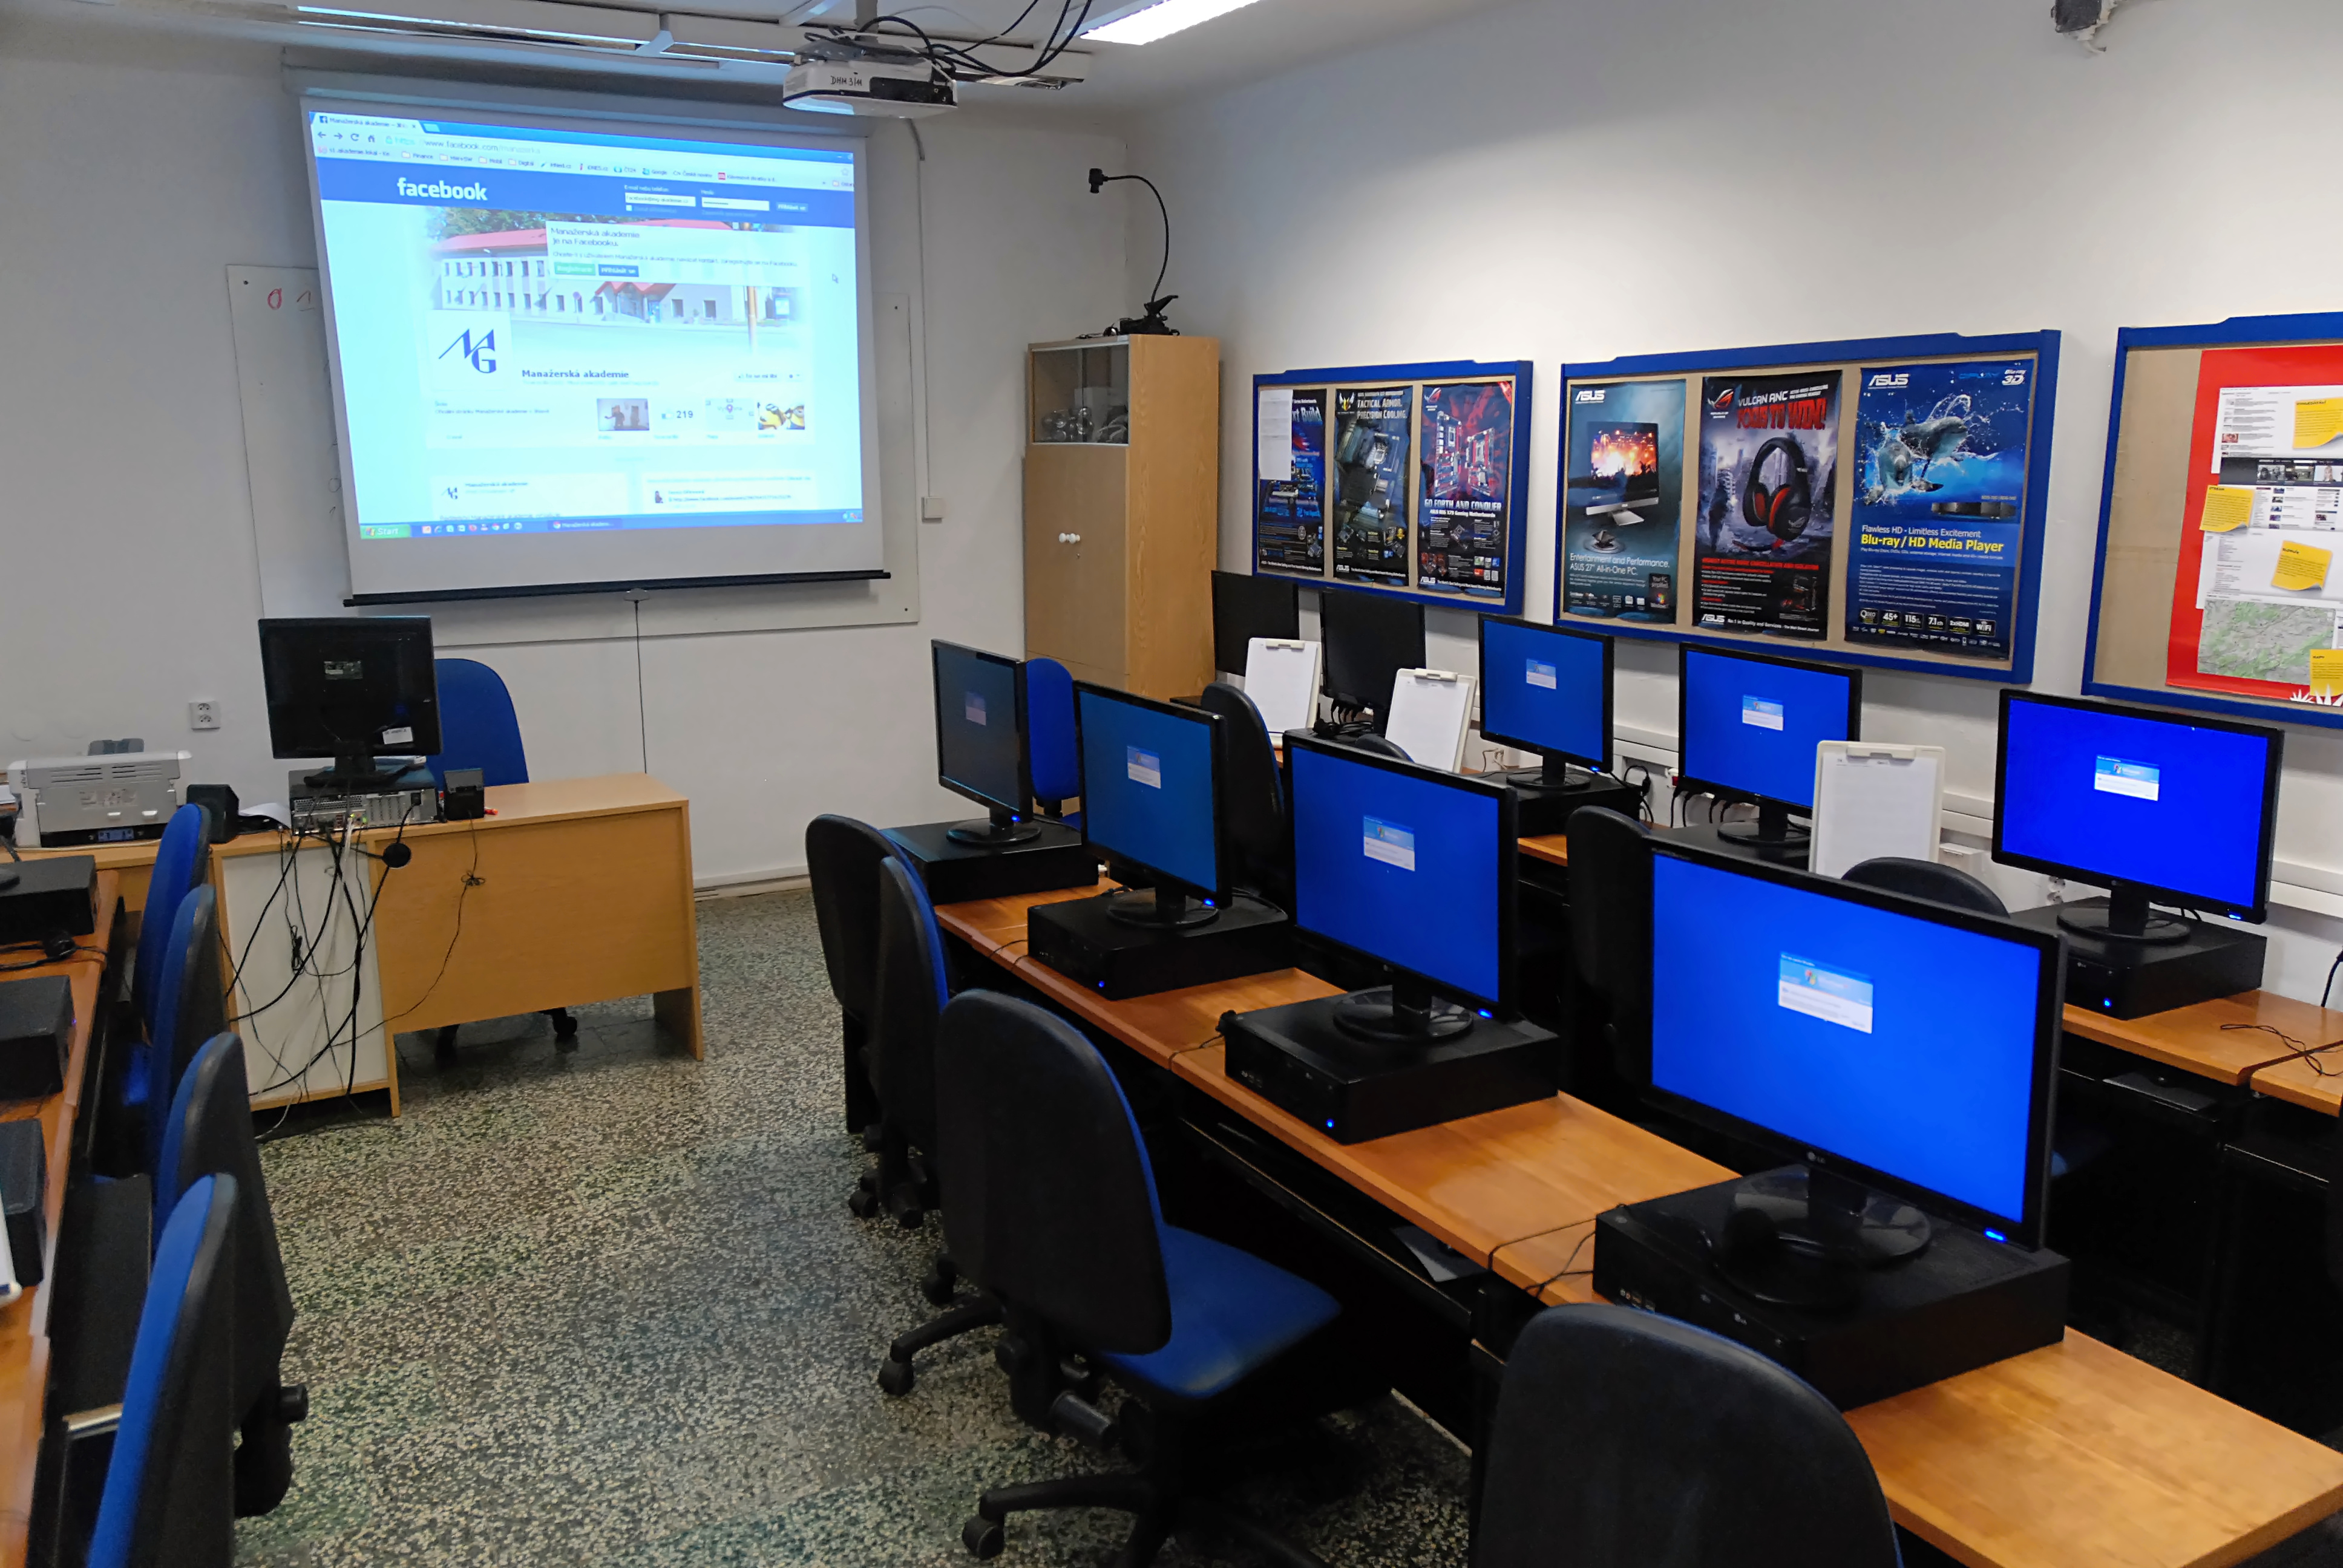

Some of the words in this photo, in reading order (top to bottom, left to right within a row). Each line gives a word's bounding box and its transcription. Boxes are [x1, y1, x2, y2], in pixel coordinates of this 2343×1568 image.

[397, 177, 488, 201] facebook
[551, 227, 600, 237] Manažerská
[601, 230, 640, 238] akademie
[522, 368, 580, 378] Manažerská
[583, 370, 629, 378] akademie
[1869, 374, 1910, 386] ASUS
[2002, 375, 2024, 385] 3D
[1576, 390, 1605, 401] ASUS
[1738, 395, 1768, 407] VULCAN
[1769, 391, 1788, 403] ANC
[1301, 407, 1323, 422] Build
[1737, 405, 1768, 429] FOCUS
[1769, 403, 1785, 429] TO
[1434, 499, 1453, 508] FORTH
[1455, 500, 1470, 509] AND
[1471, 501, 1501, 511] CONQUER
[377, 527, 399, 535] Start
[1862, 524, 1890, 534] Flawless
[1909, 527, 1938, 536] Limitless
[1941, 529, 1982, 538] Excitement
[1861, 534, 1901, 547] Blu-ray
[1909, 537, 1925, 547] HD
[1928, 538, 1962, 550] Media
[1965, 540, 2004, 554] Player
[1570, 553, 1611, 563] Entertainment
[1627, 557, 1670, 568] Performance.
[1596, 566, 1626, 574] All-in-One
[1702, 614, 1725, 623] ASUS
[1883, 612, 1898, 621] 45+
[1905, 615, 1916, 623] 115
